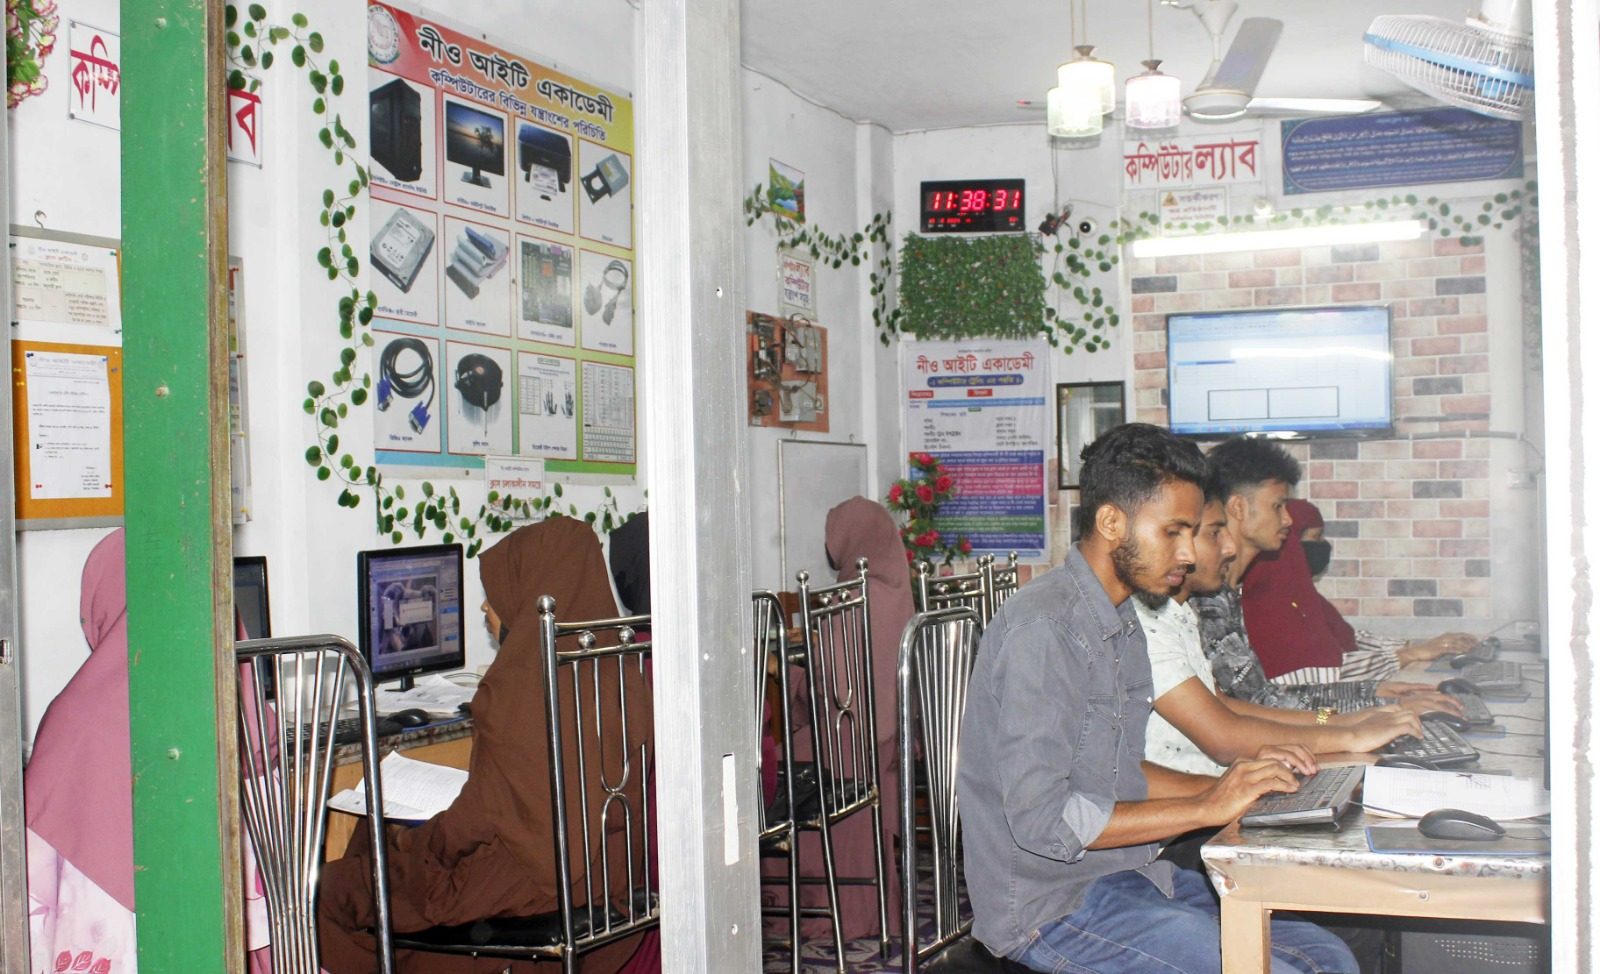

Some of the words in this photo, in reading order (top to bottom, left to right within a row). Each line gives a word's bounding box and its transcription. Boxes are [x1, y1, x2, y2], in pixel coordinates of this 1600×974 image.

[418, 26, 461, 65] নীও
[468, 54, 529, 88] আইটি
[537, 80, 614, 123] একাডেমী
[430, 69, 496, 104] কম্পিউটারের
[499, 90, 528, 116] বিভিন্ন
[573, 119, 606, 141] পরিচিতি
[932, 189, 1022, 211] 11:38:31
[942, 353, 979, 373] আইটি
[982, 350, 1036, 372] একাডেমী
